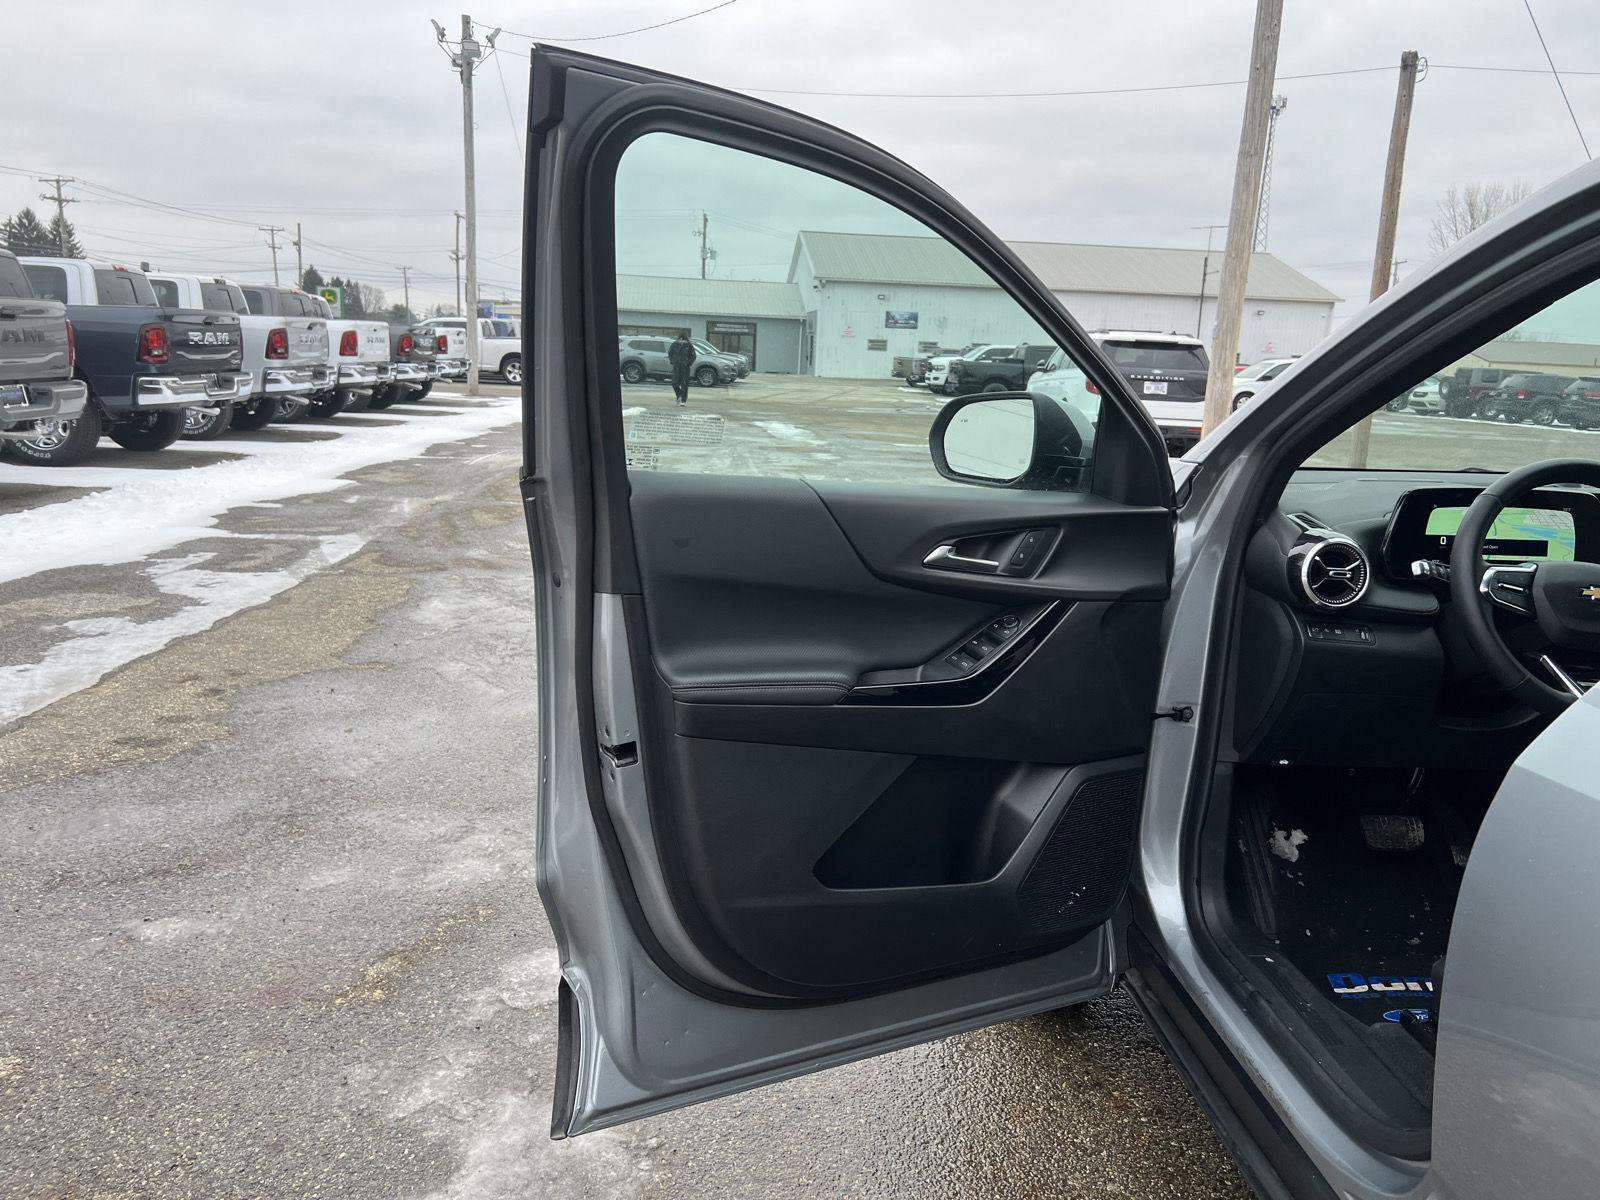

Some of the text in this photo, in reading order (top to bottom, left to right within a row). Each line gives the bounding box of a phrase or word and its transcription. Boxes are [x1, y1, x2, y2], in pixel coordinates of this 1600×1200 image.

[0, 328, 46, 344] AM
[188, 331, 230, 345] RAM
[1439, 535, 1447, 545] 0
